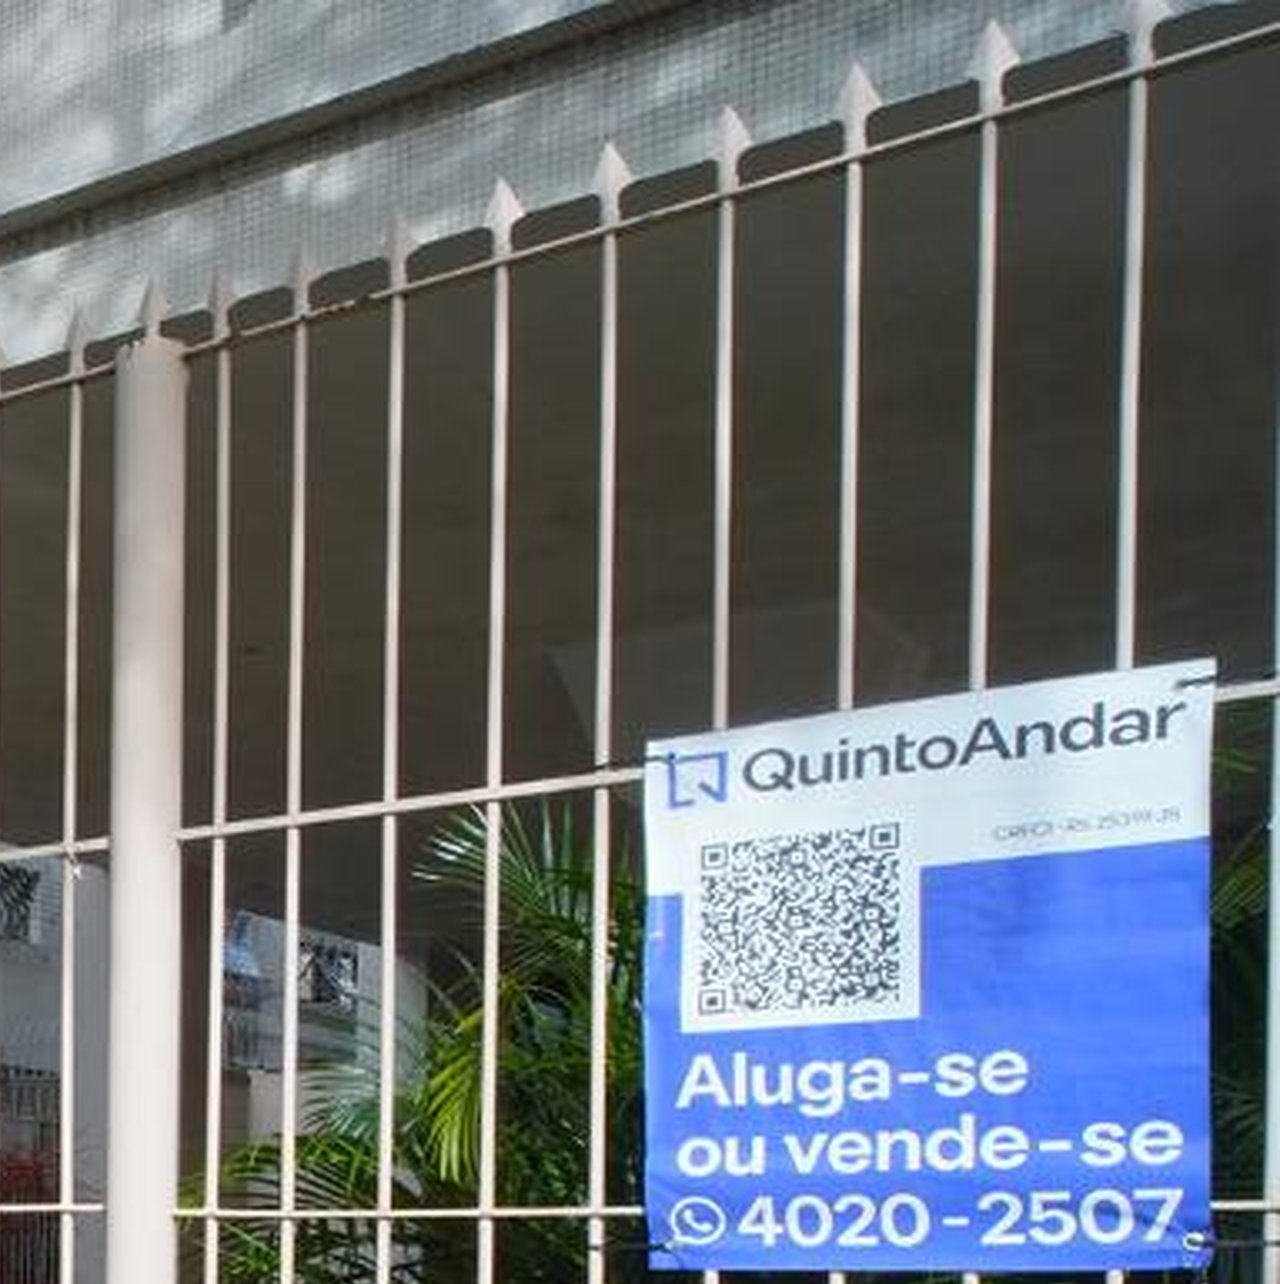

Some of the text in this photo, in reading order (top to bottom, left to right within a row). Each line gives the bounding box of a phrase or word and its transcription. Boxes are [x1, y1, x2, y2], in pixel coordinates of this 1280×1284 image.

[742, 701, 1188, 794] QuintoAndar
[675, 1048, 1029, 1118] Aluga-se
[675, 1112, 1184, 1178] ou vende-se
[738, 1187, 1184, 1248] 4020-2507
